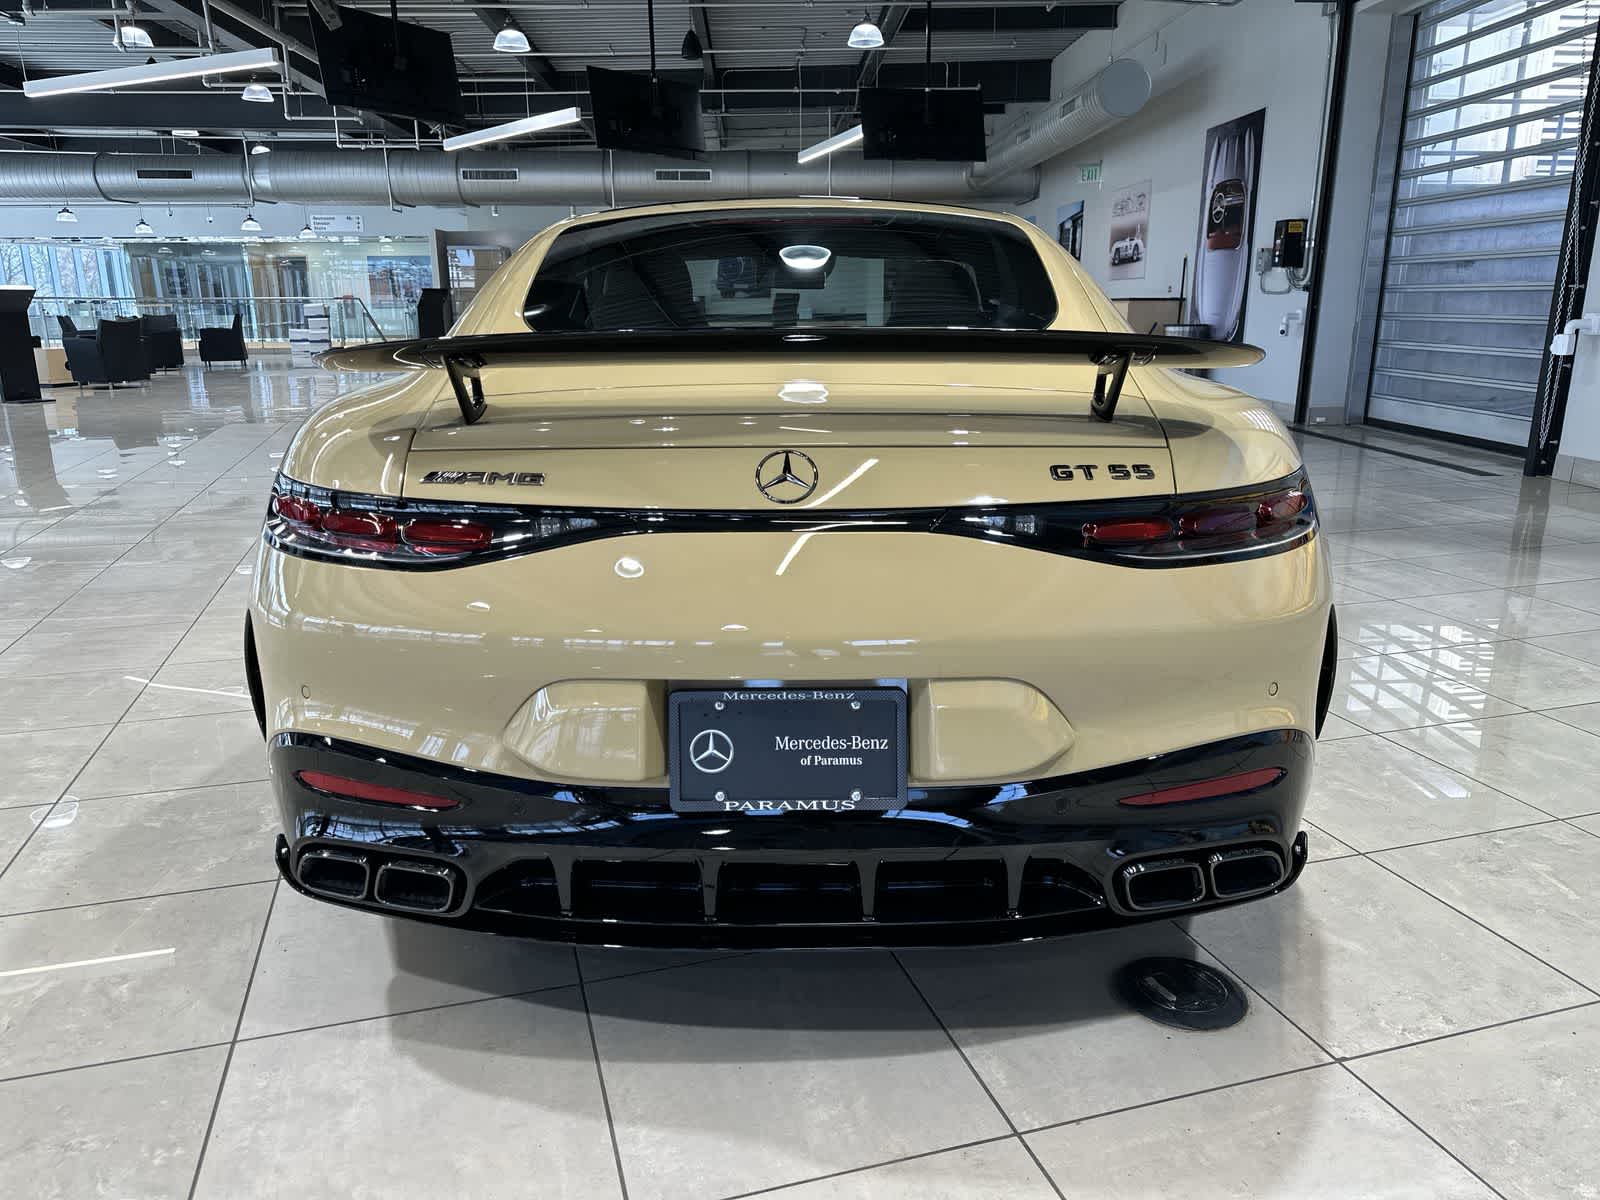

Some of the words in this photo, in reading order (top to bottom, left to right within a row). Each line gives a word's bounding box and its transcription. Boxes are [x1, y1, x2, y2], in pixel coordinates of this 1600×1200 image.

[1081, 167, 1098, 181] EXIT
[454, 471, 545, 486] AMG
[1049, 464, 1098, 481] GT
[1107, 464, 1155, 480] 55
[722, 690, 856, 701] Mercedes-Benz
[775, 735, 889, 751] Mercedes-Benz
[800, 755, 813, 766] of
[814, 755, 863, 766] Paramus
[724, 800, 856, 811] PARAMUS
